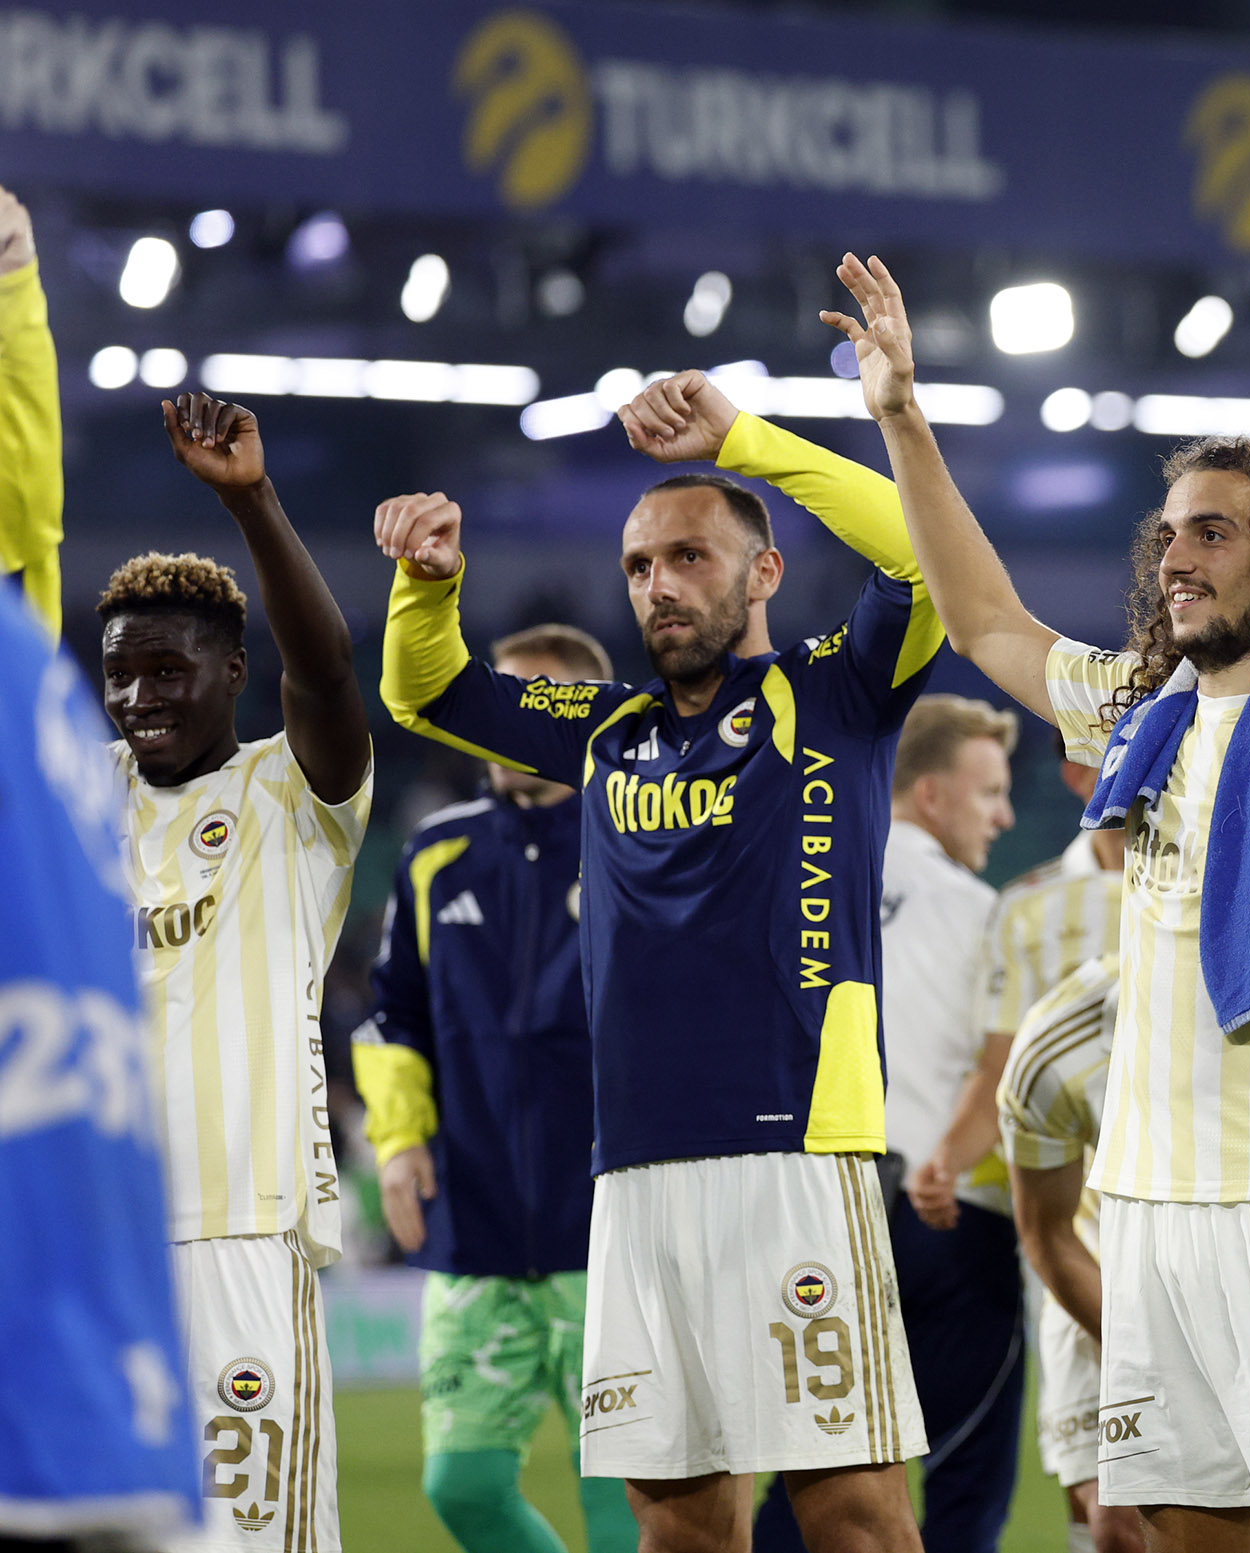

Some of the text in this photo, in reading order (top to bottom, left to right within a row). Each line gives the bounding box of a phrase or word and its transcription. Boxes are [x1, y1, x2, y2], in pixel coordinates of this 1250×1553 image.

[600, 58, 998, 197] TURKCELL
[801, 747, 835, 989] ACIBADEM
[307, 962, 340, 1205] CIBADEM
[769, 1316, 855, 1404] 19
[202, 1416, 284, 1502] 21
